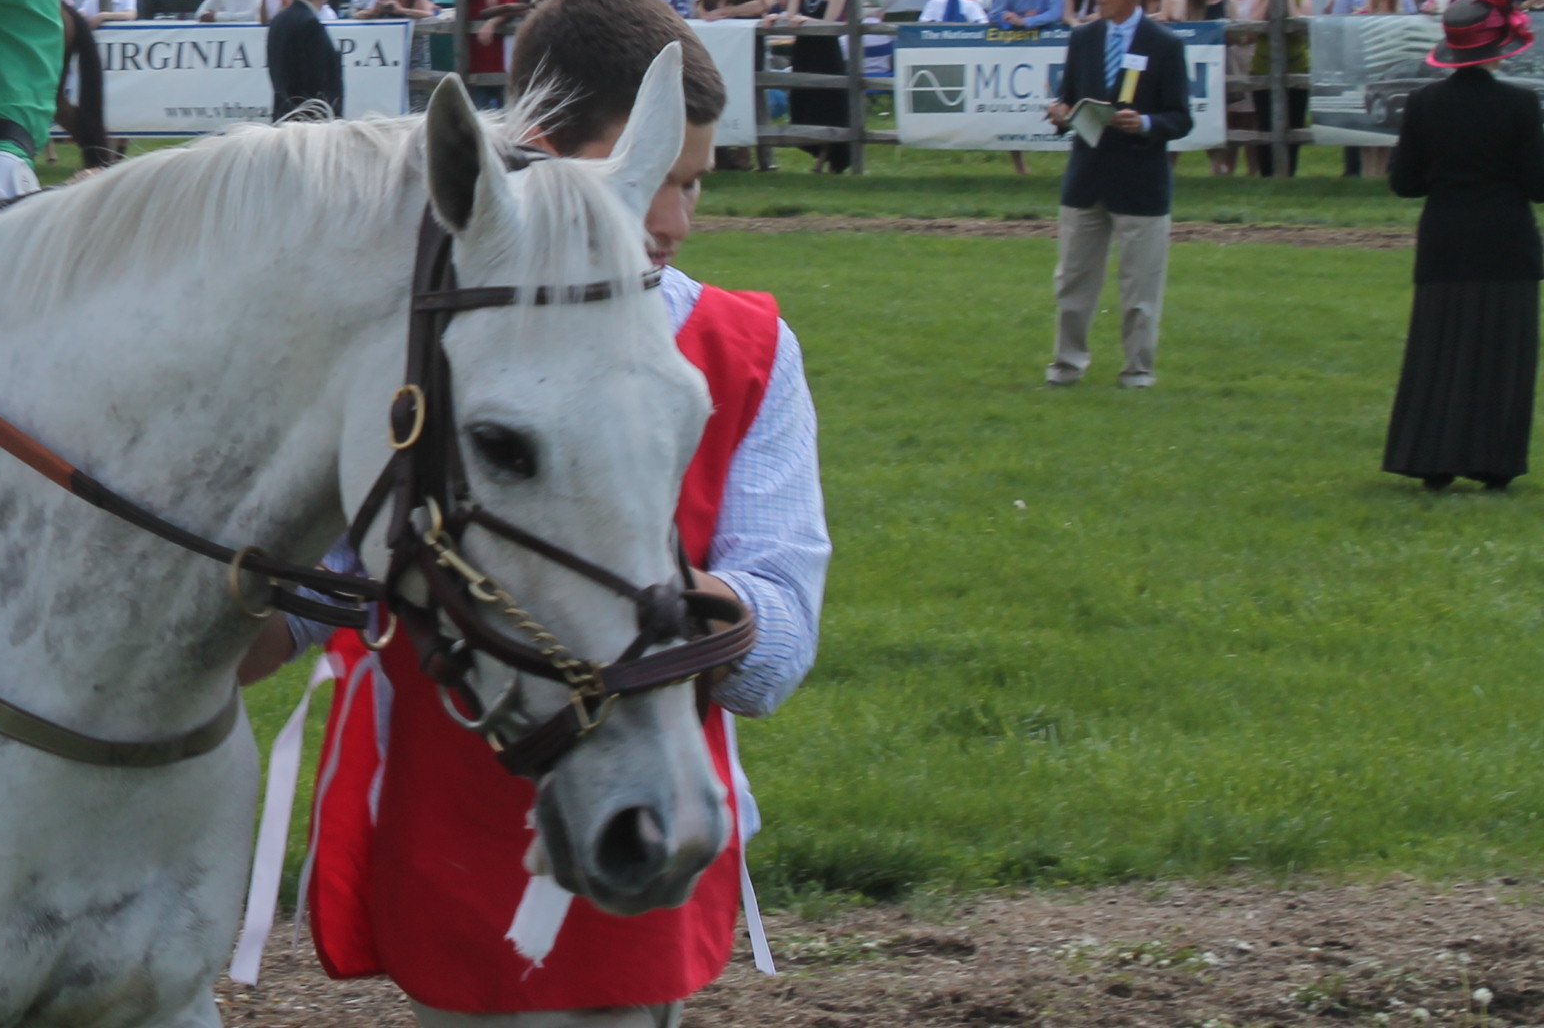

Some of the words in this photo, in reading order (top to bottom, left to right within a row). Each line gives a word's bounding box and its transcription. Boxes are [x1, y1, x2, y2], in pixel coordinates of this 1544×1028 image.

[920, 30, 941, 39] The
[941, 30, 985, 40] National
[985, 27, 1040, 43] Expert
[99, 40, 253, 71] IRGINIA
[974, 63, 1039, 99] M.C.
[976, 104, 1049, 113] BUILDIN
